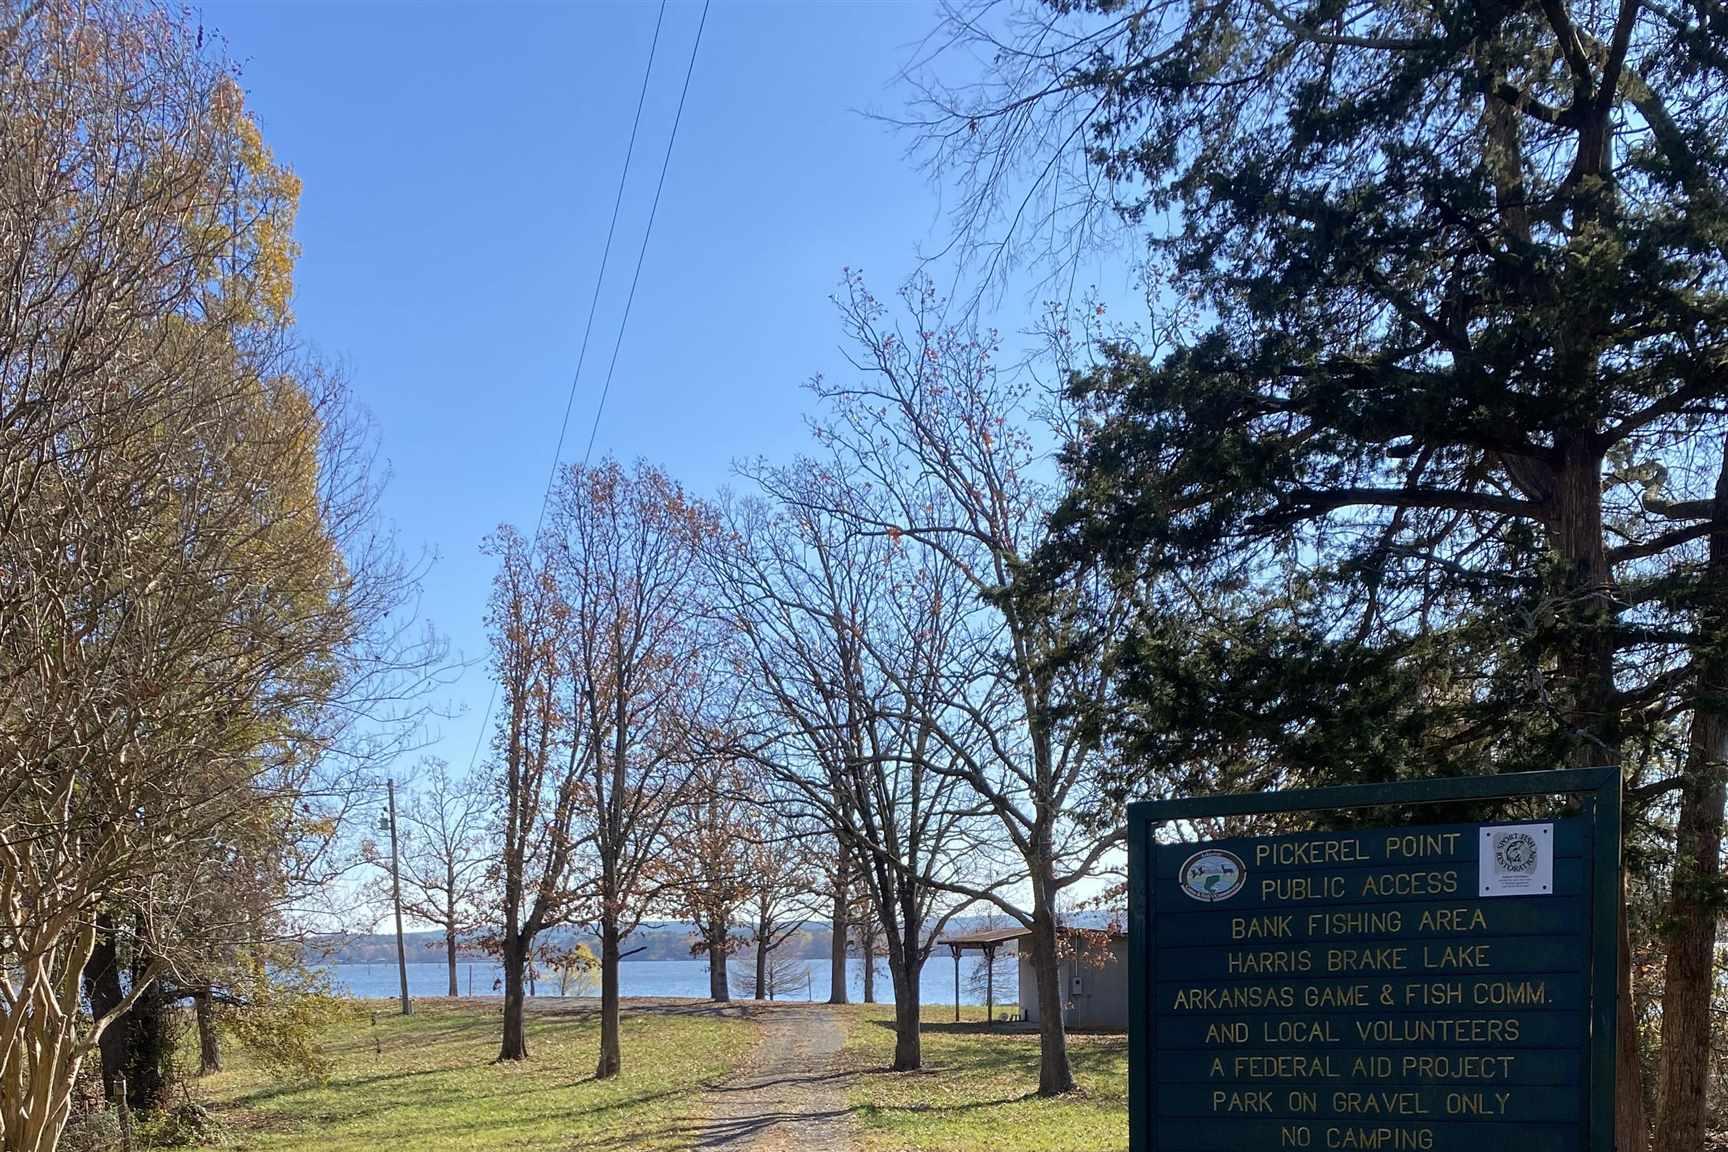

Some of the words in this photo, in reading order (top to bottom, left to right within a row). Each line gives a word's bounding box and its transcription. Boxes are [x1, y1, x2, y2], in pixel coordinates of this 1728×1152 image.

[1256, 840, 1369, 866] PICKEREL
[1386, 833, 1461, 858] POINT
[1497, 833, 1517, 849] SPORT
[1519, 834, 1536, 848] FISH
[1262, 877, 1345, 901] PUBLIC
[1362, 872, 1458, 897] ACCESS
[1232, 915, 1292, 938] BANK
[1308, 911, 1401, 935] FISHING
[1419, 909, 1487, 931] AREA
[1228, 950, 1312, 973] HARRIS
[1328, 948, 1407, 971] BRAKE
[1424, 946, 1491, 968] LAKE
[1174, 986, 1294, 1010] ARKANSAS
[1305, 985, 1369, 1006] GAME
[1380, 985, 1394, 1005] &
[1406, 984, 1462, 1005] FISH
[1474, 982, 1552, 1004] COMM.
[1206, 1022, 1248, 1043] AND
[1264, 1021, 1340, 1042] LOCAL
[1357, 1020, 1520, 1042] VOLUNTEERS
[1210, 1057, 1224, 1077] A
[1235, 1056, 1340, 1078] FEDERAL
[1352, 1056, 1391, 1078] AID
[1402, 1056, 1514, 1078] PROJECT
[1213, 1092, 1273, 1112] PARK
[1289, 1093, 1317, 1113] ON
[1333, 1093, 1427, 1114] GRAVEL
[1447, 1093, 1510, 1115] ONLY
[1281, 1127, 1310, 1146] NO
[1327, 1128, 1433, 1150] CAMPING
